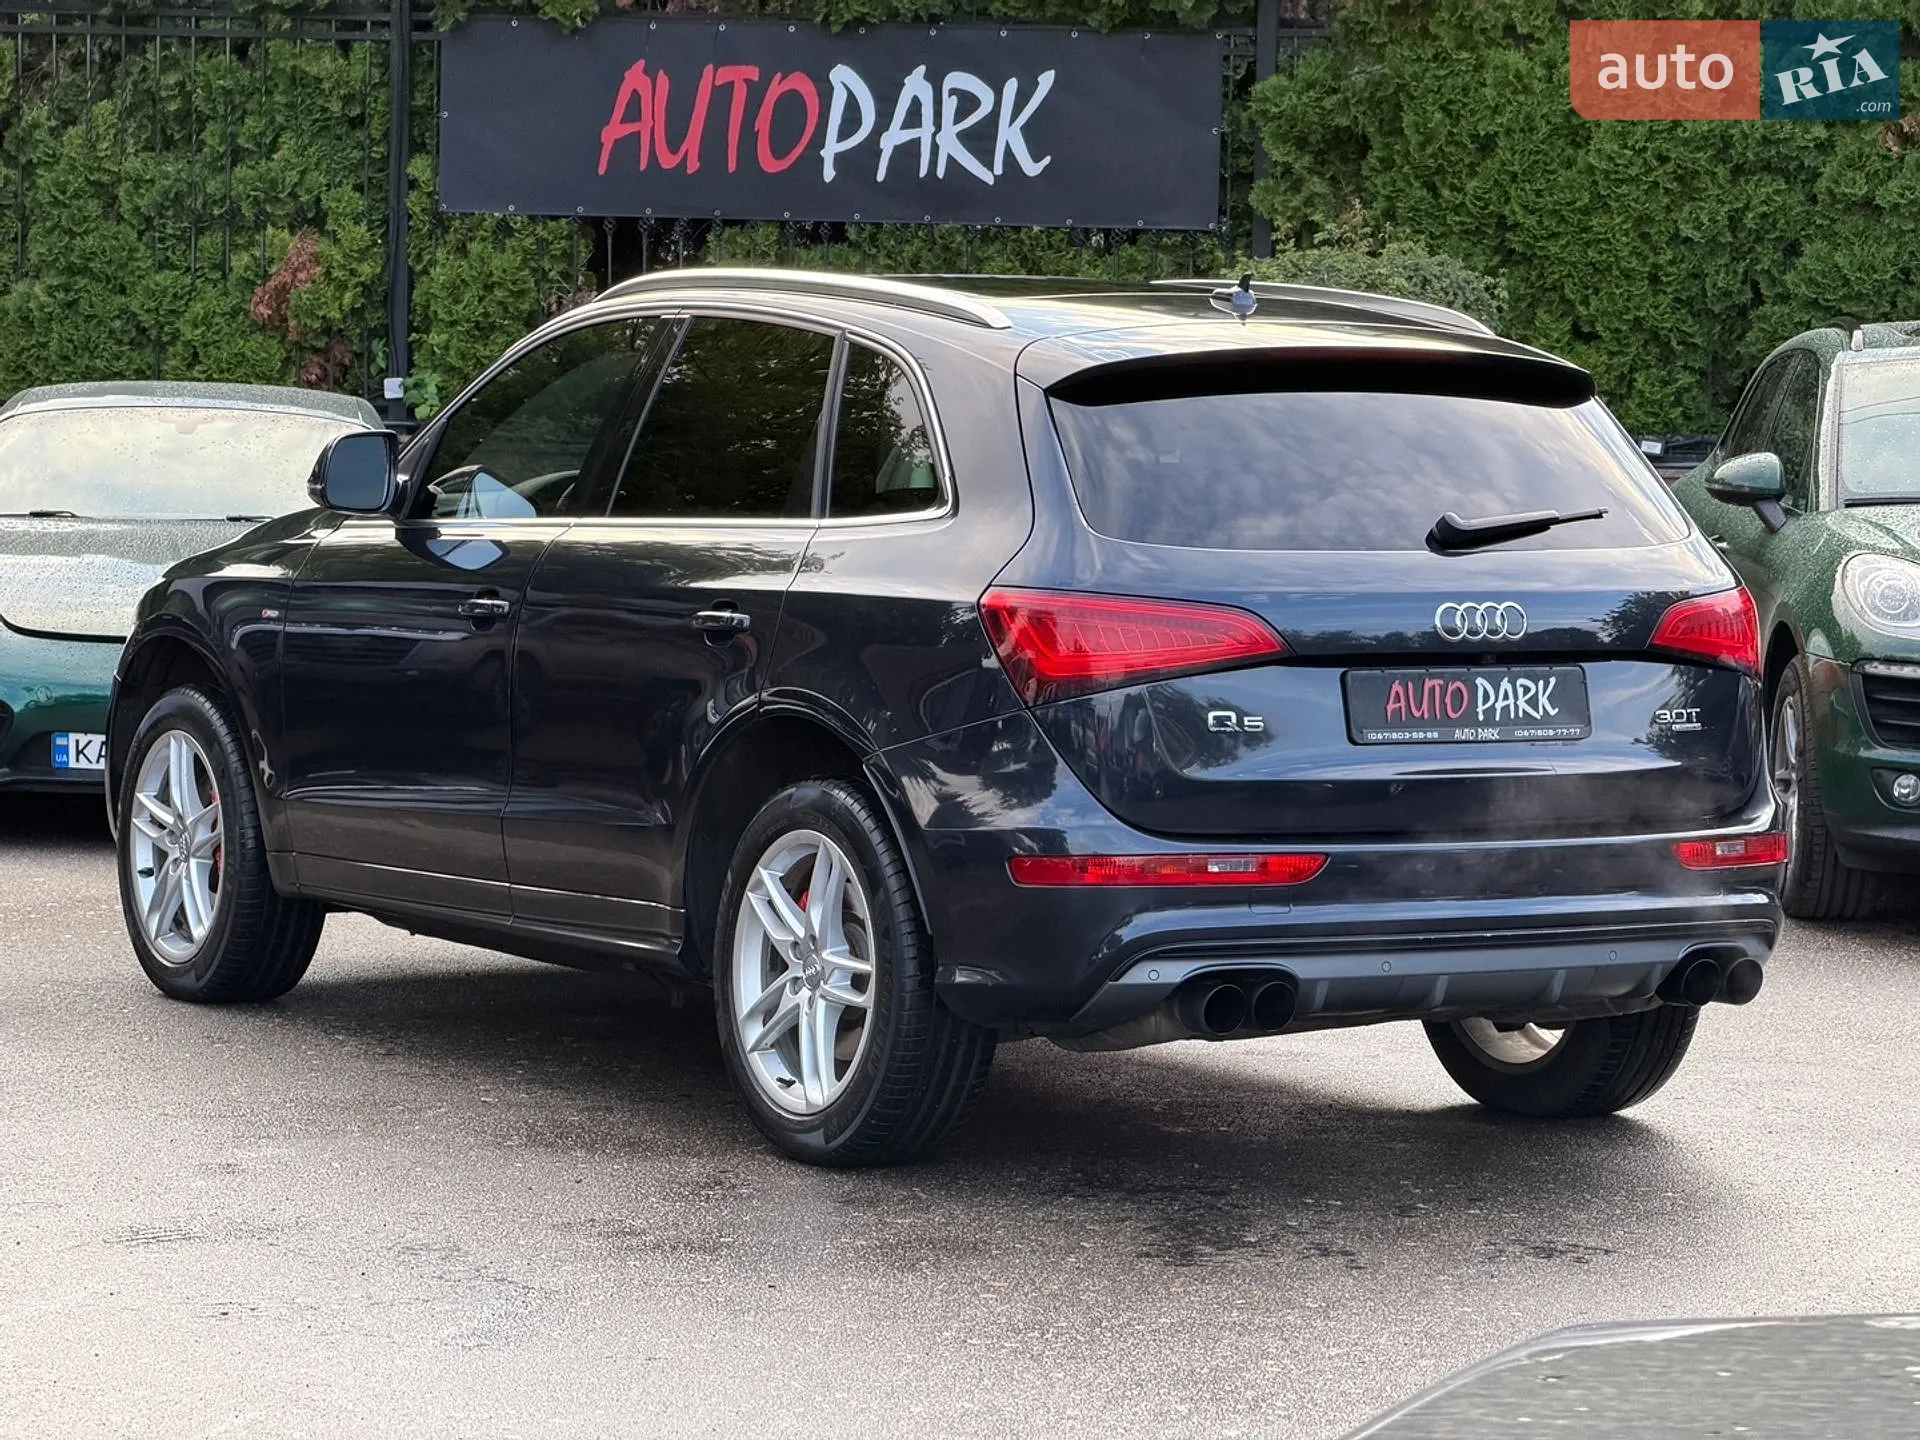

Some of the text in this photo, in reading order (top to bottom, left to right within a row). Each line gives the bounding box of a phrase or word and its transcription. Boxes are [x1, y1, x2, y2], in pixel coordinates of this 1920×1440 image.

[1386, 677, 1559, 724] AUTO PARK
[1208, 711, 1264, 732] Q5
[1654, 708, 1701, 723] 3.0T
[1454, 727, 1500, 741] AUTO PARK
[55, 754, 68, 762] UA
